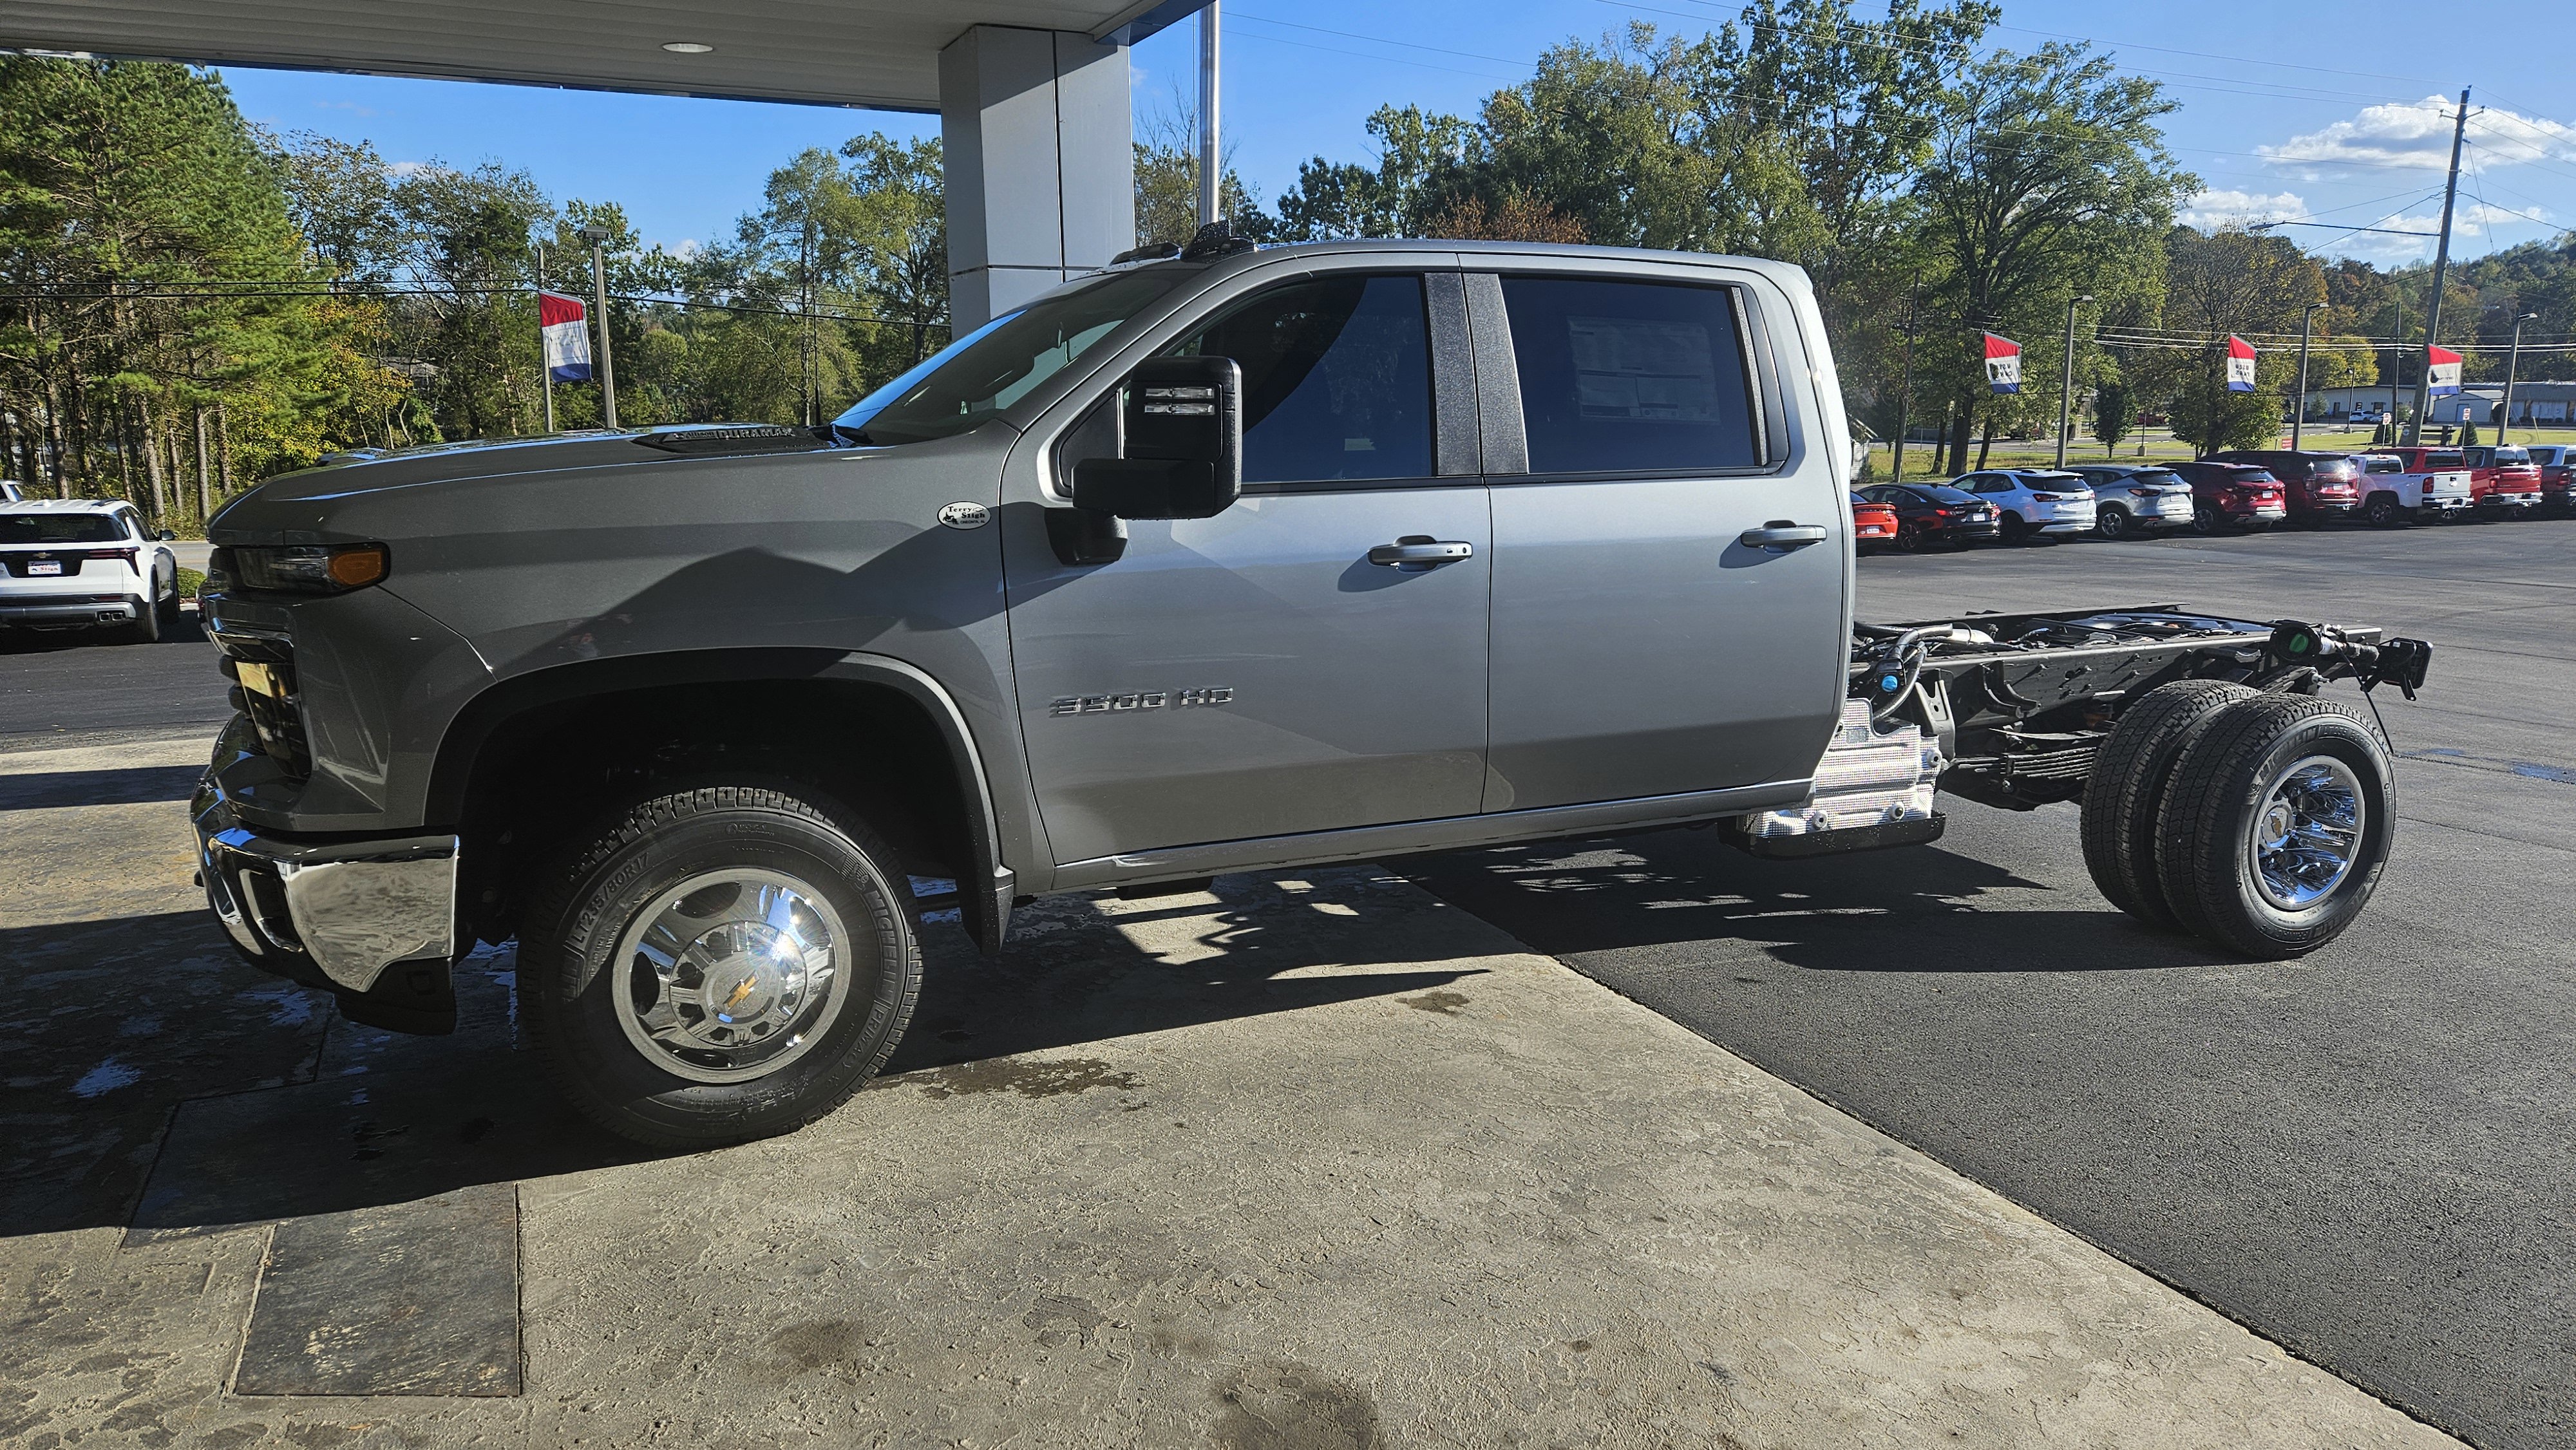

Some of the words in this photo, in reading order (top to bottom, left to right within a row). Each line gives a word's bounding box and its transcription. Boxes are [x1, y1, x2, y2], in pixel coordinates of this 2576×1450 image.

[720, 428, 795, 439] DURAMAX
[1056, 692, 1166, 715] 3500
[1179, 687, 1234, 706] HD
[571, 852, 649, 945] LT235/80R17
[866, 890, 897, 997] MICHELIN
[839, 1008, 886, 1071] PRIMACY
